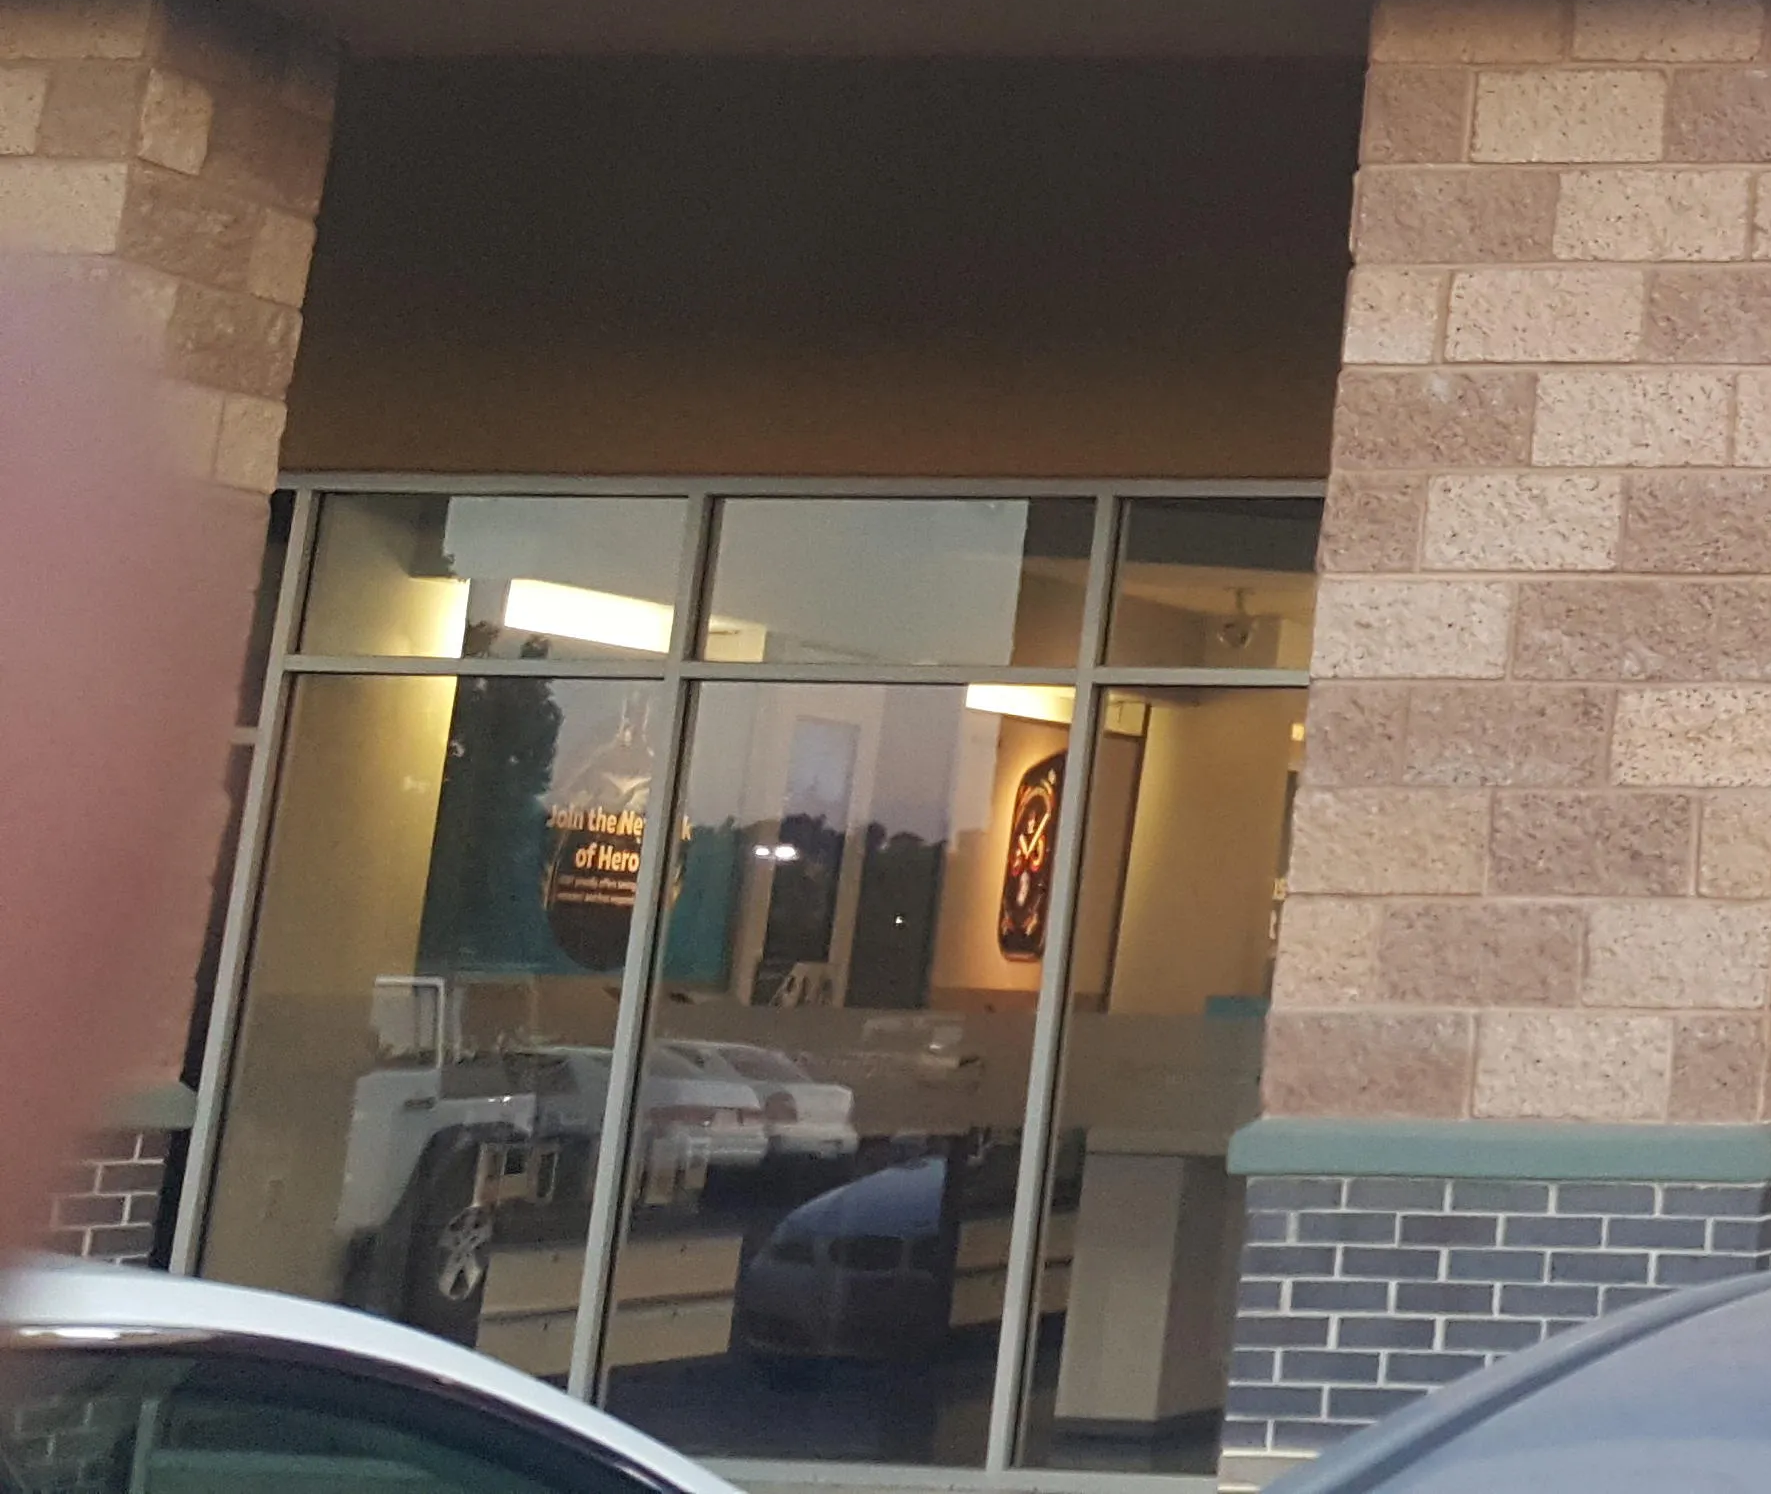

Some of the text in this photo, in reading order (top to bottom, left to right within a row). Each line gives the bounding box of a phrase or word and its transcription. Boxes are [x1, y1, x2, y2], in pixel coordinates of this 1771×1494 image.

[546, 804, 585, 830] Join
[588, 806, 617, 834] the
[575, 842, 640, 873] of Hero
